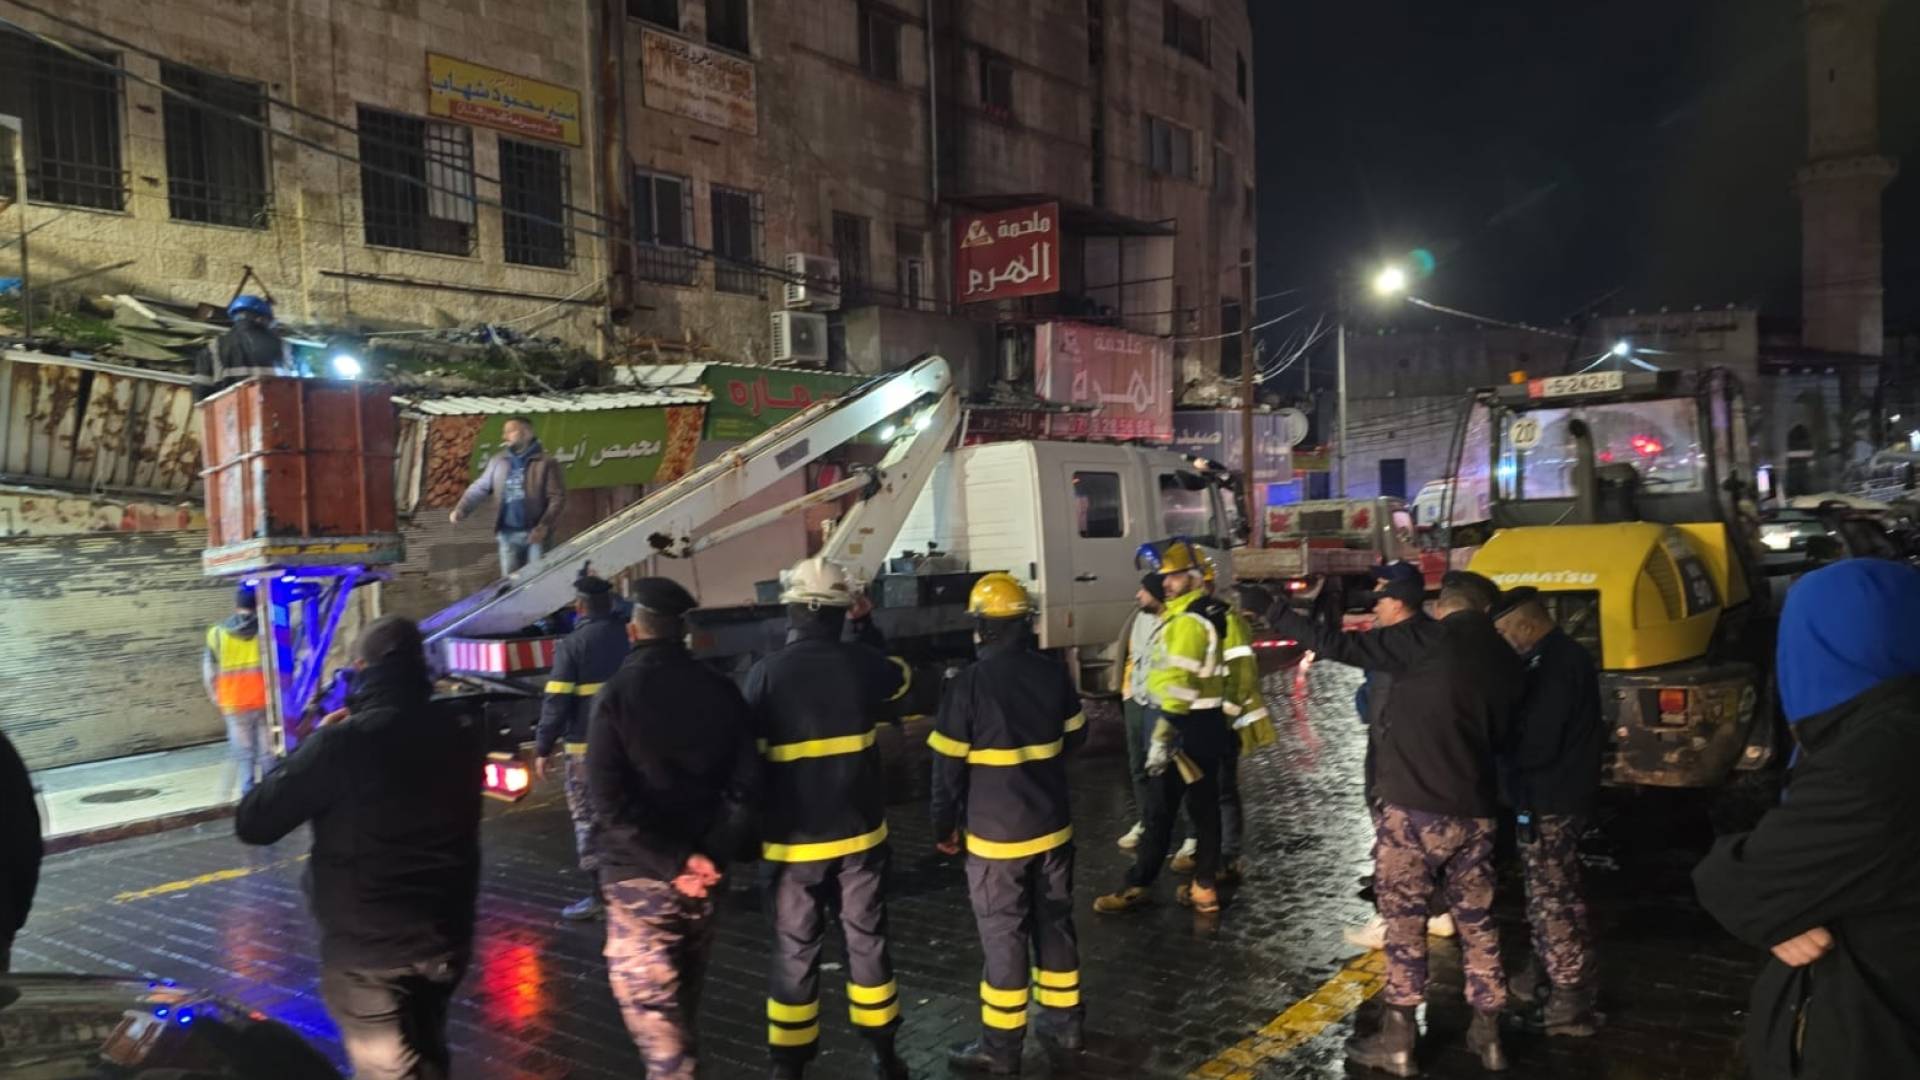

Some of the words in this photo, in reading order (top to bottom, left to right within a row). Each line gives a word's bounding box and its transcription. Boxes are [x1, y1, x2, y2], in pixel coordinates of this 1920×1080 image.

[431, 68, 490, 101] شهاب
[491, 87, 546, 112] محمود
[997, 209, 1051, 238] ملحمة
[963, 241, 1051, 296] الهرم
[1093, 331, 1143, 355] ملحمة
[1515, 421, 1537, 443] 20
[588, 438, 662, 468] محمص
[1490, 569, 1598, 586] KOMATSU
